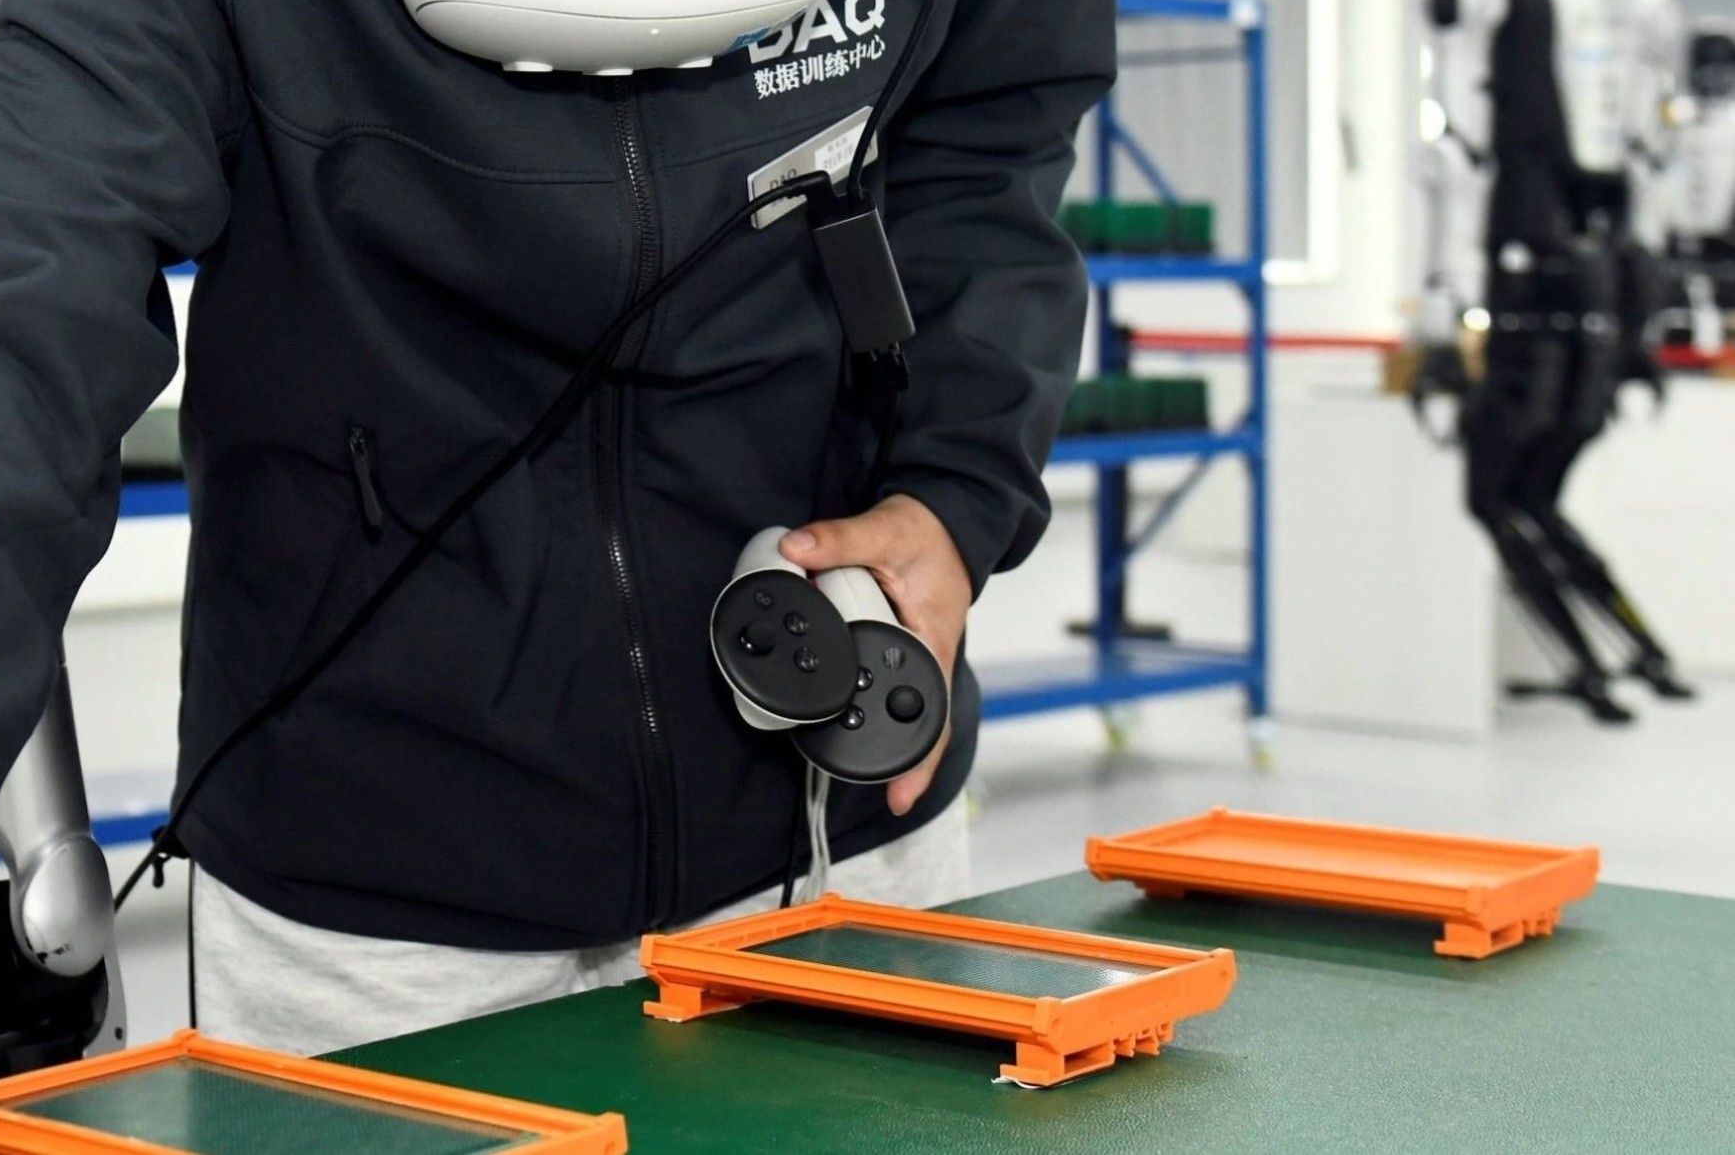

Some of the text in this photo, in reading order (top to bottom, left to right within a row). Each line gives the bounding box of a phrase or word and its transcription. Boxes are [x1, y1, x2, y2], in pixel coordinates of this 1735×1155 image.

[754, 34, 886, 100] 数据训练中心
